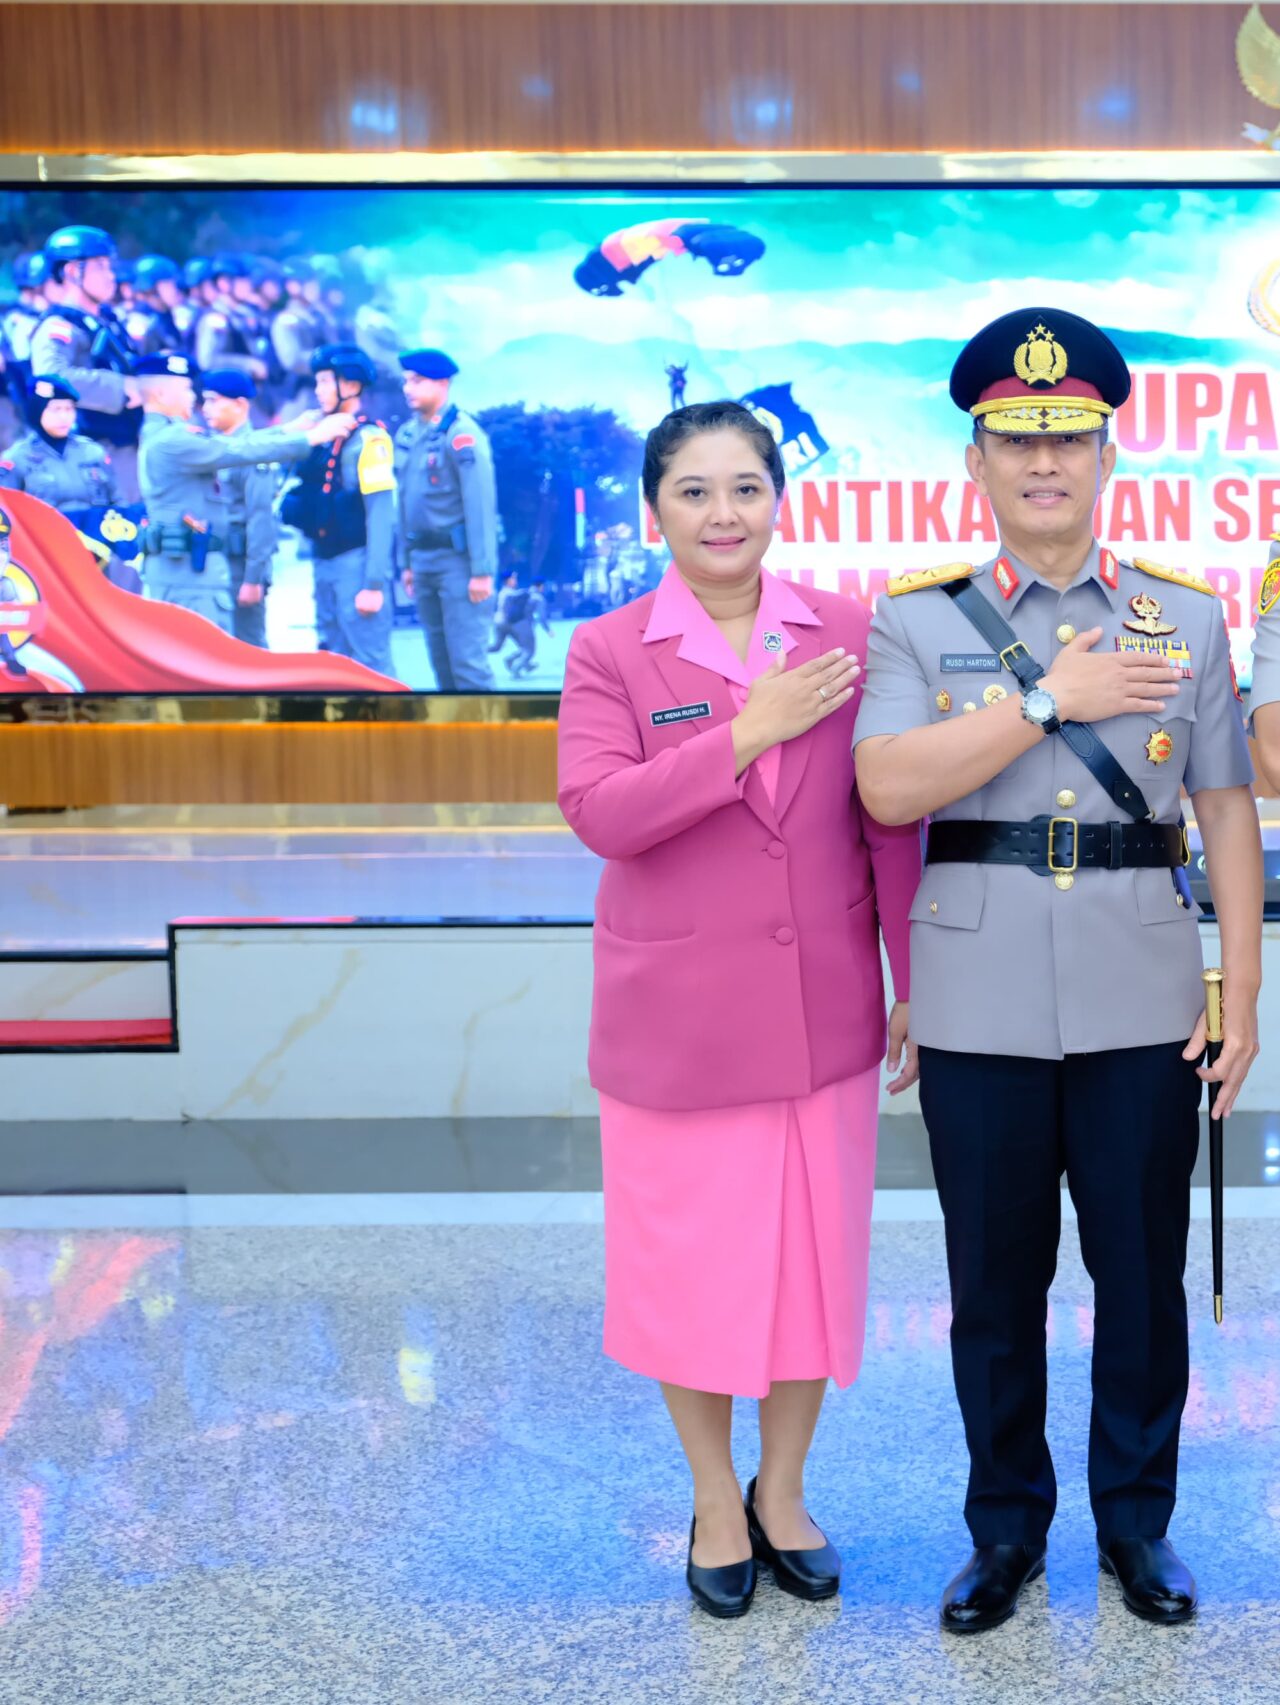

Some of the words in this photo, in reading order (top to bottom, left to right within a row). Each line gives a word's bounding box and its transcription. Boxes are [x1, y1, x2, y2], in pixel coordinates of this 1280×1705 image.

[1092, 479, 1190, 542] AN
[945, 658, 965, 667] RUSDI
[966, 658, 996, 667] HARTONO
[682, 708, 699, 716] RUSDI
